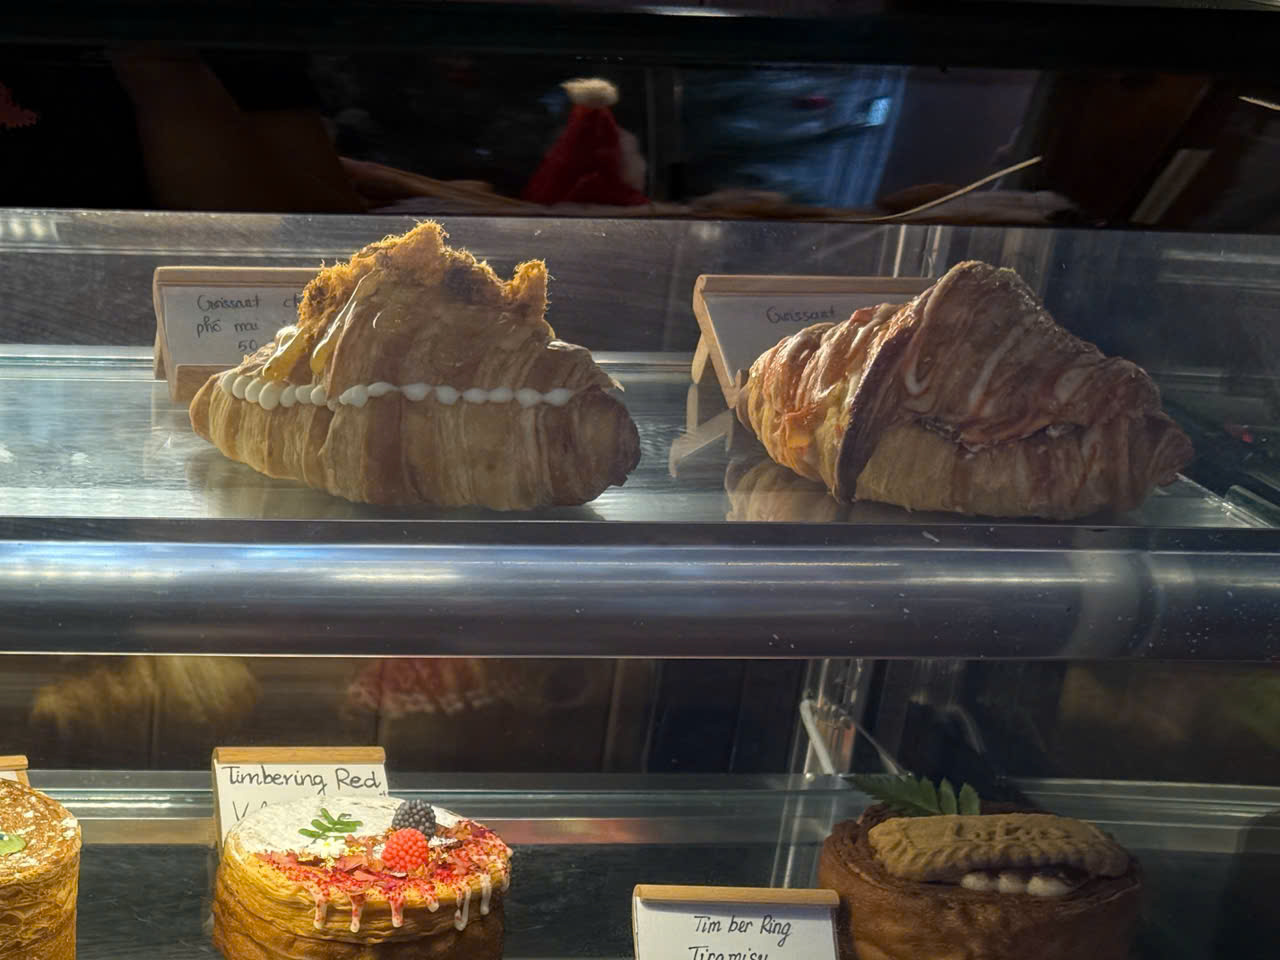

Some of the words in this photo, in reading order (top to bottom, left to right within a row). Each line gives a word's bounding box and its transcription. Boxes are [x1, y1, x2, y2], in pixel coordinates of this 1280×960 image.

[221, 765, 328, 796] Timbering
[335, 767, 382, 790] Red
[760, 914, 792, 947] Ring
